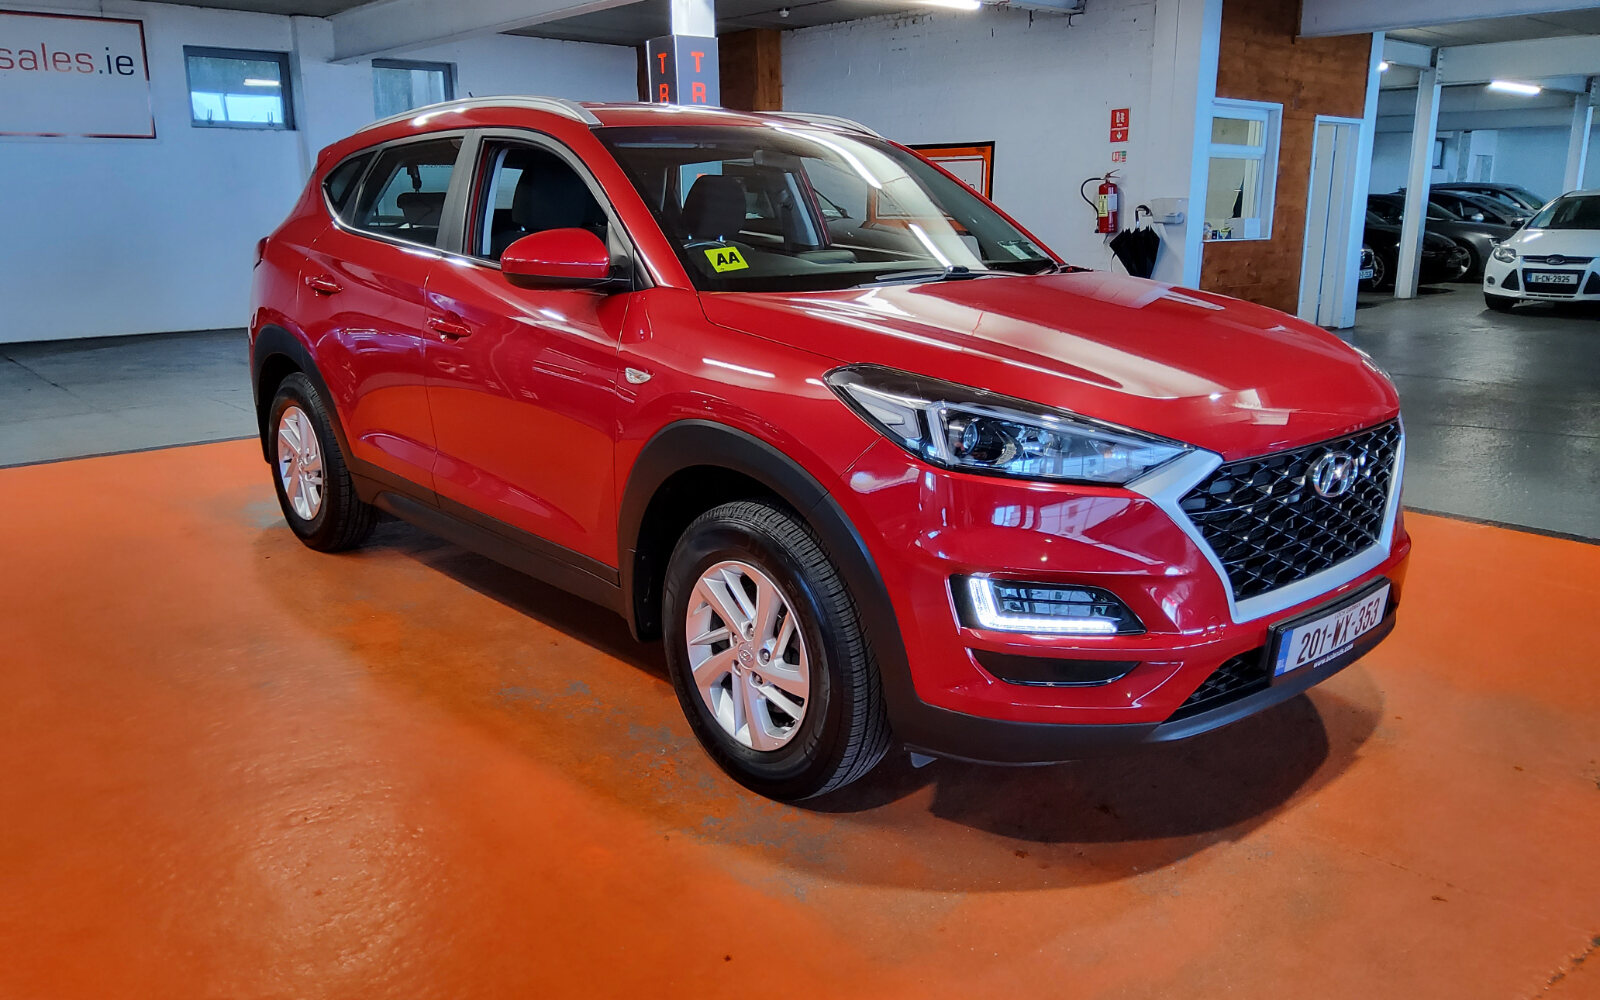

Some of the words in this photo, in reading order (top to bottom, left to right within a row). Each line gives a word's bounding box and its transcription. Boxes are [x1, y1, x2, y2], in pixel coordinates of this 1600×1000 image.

[0, 42, 135, 76] sales.ie
[716, 251, 740, 267] AA
[1296, 597, 1381, 665] 201-WX-353
